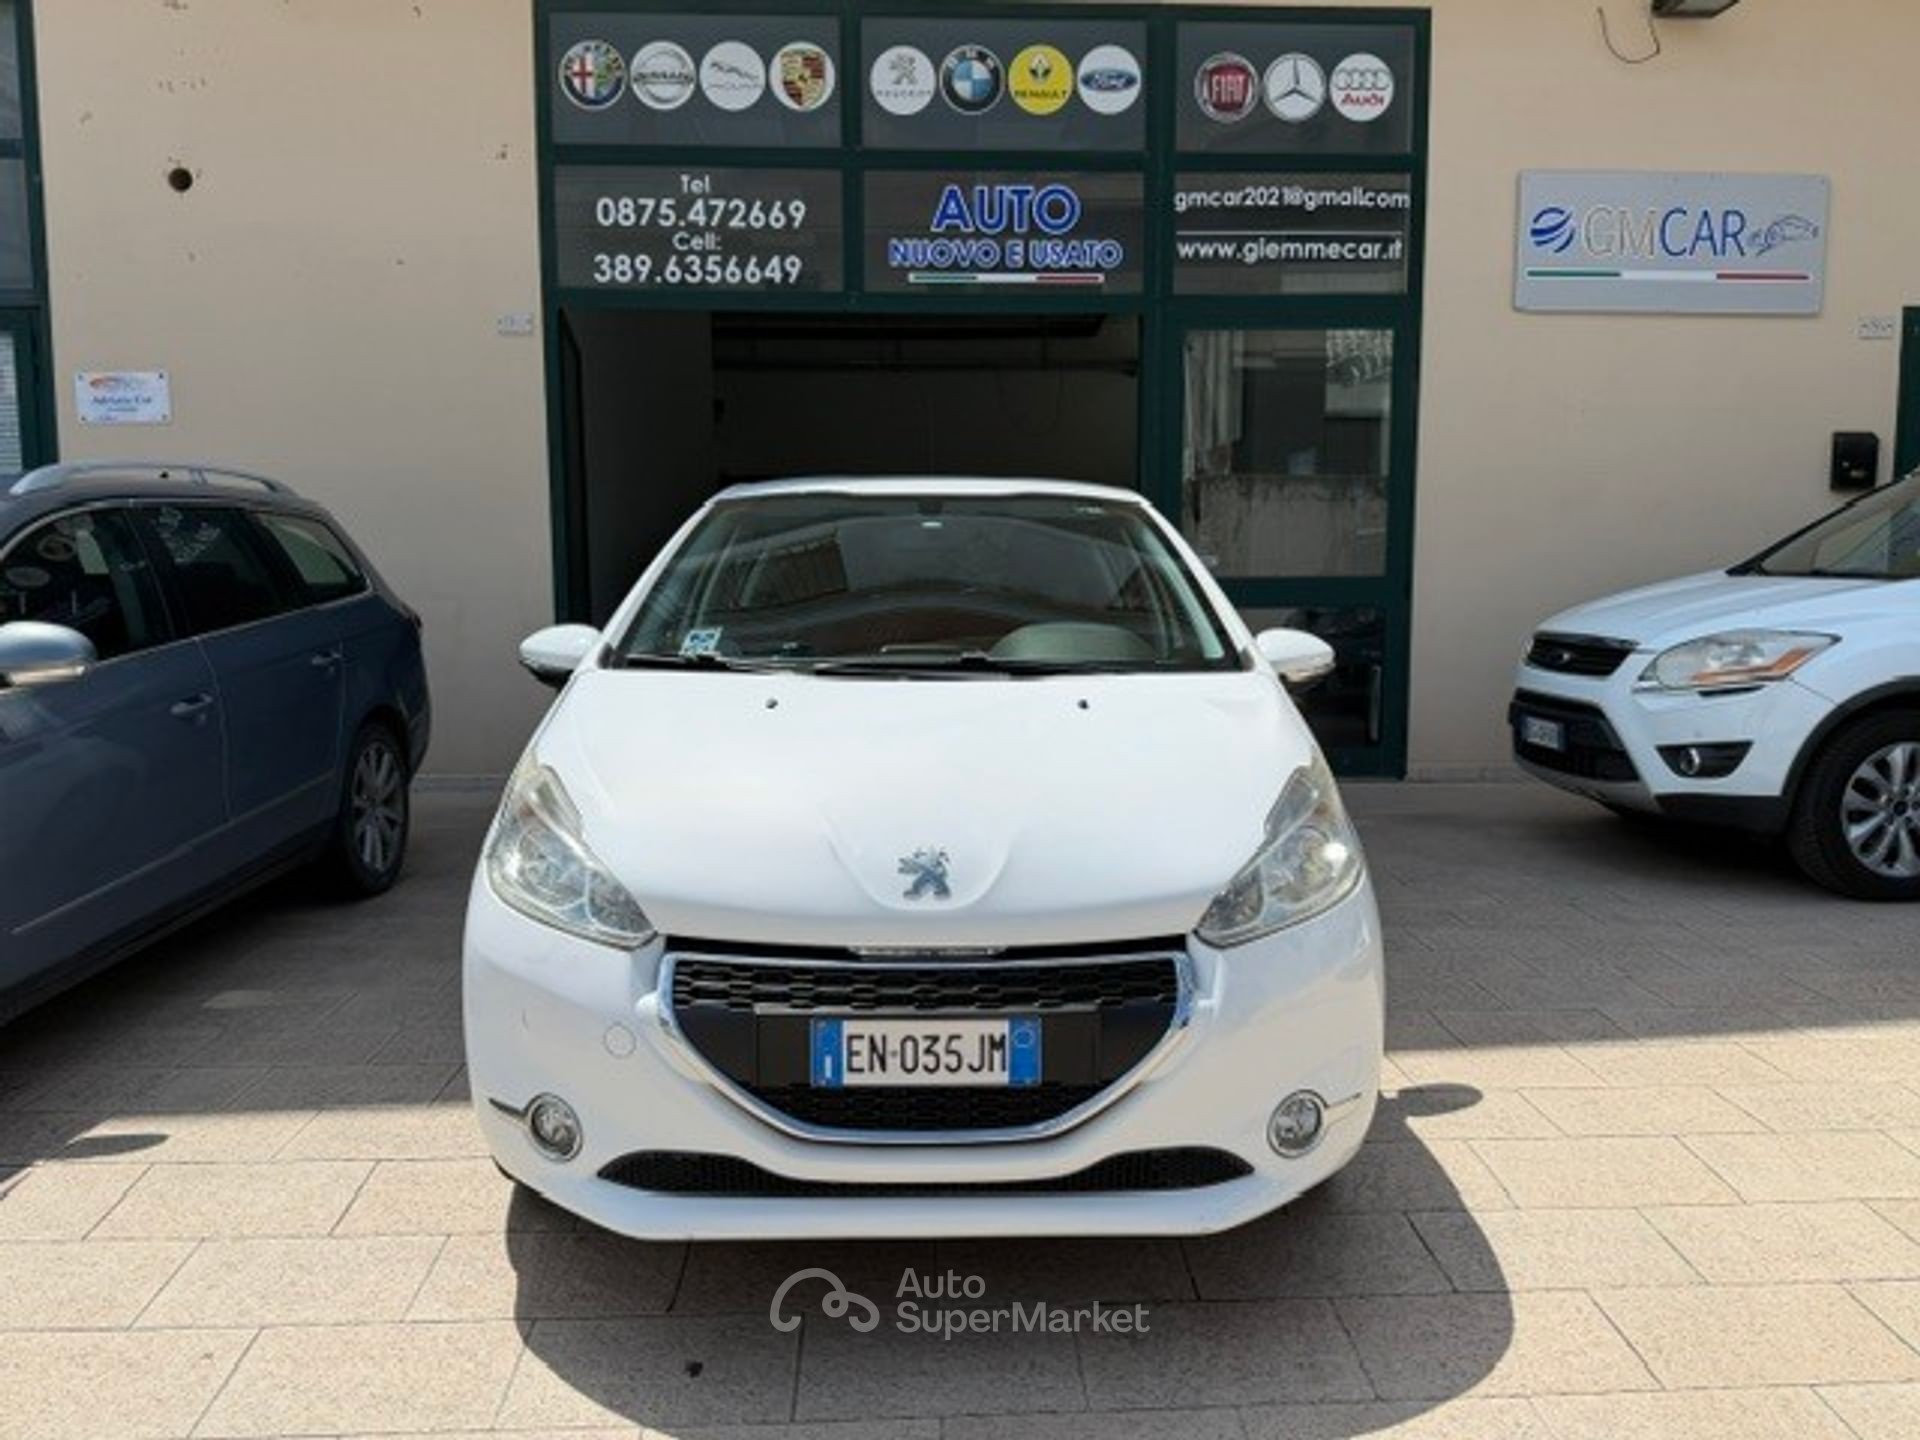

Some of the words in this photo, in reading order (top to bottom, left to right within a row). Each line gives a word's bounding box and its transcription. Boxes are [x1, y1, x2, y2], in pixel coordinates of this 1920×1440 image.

[1212, 74, 1246, 104] FIAT
[1341, 95, 1384, 106] Audi
[681, 174, 710, 193] Tel
[595, 197, 806, 229] 0875.472669
[931, 184, 1080, 234] AUTO
[672, 232, 722, 250] Cell:
[1583, 206, 1747, 258] GMCAR
[888, 239, 1000, 268] NUOVO
[1005, 240, 1025, 268] E
[1030, 240, 1124, 269] USATO
[1177, 238, 1403, 263] www.giemmecar.it
[593, 254, 802, 284] 389.6356649
